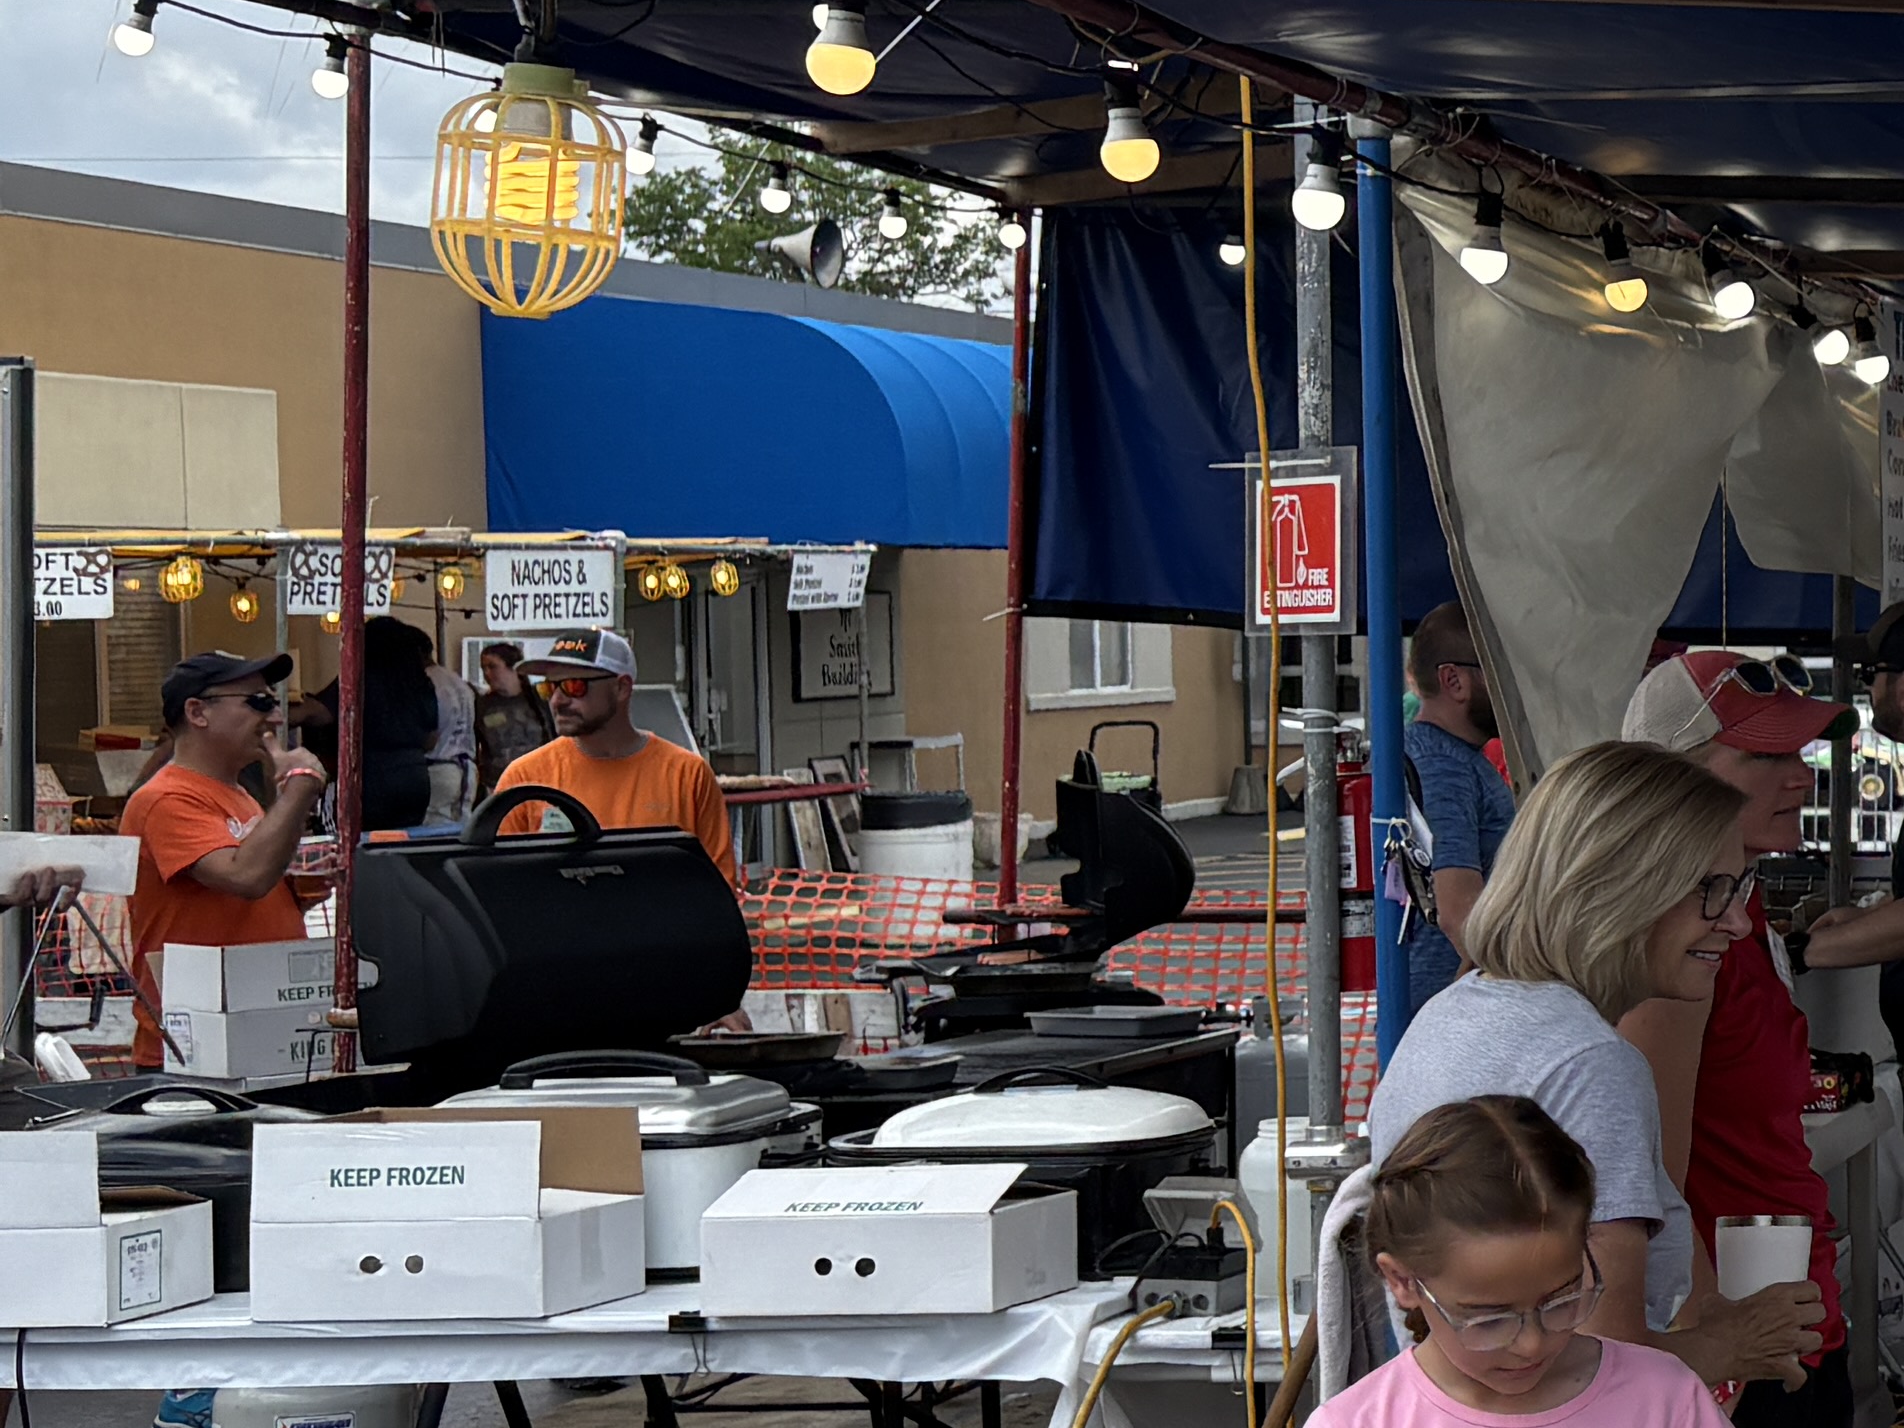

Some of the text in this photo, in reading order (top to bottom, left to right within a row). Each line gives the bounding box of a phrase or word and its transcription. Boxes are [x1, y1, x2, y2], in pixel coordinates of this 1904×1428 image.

[34, 552, 74, 571] OFT
[318, 553, 342, 577] SO
[511, 559, 587, 587] NACHOS &
[1308, 568, 1329, 586] FIRE
[289, 581, 388, 607] PRETLS
[1263, 588, 1333, 609] ETINGUISHER
[490, 591, 609, 621] SOFT PRETZELS
[277, 986, 315, 1002] KEEP
[329, 1164, 465, 1188] KEEP FROZEN
[783, 1200, 924, 1213] KEEP FROZEN
